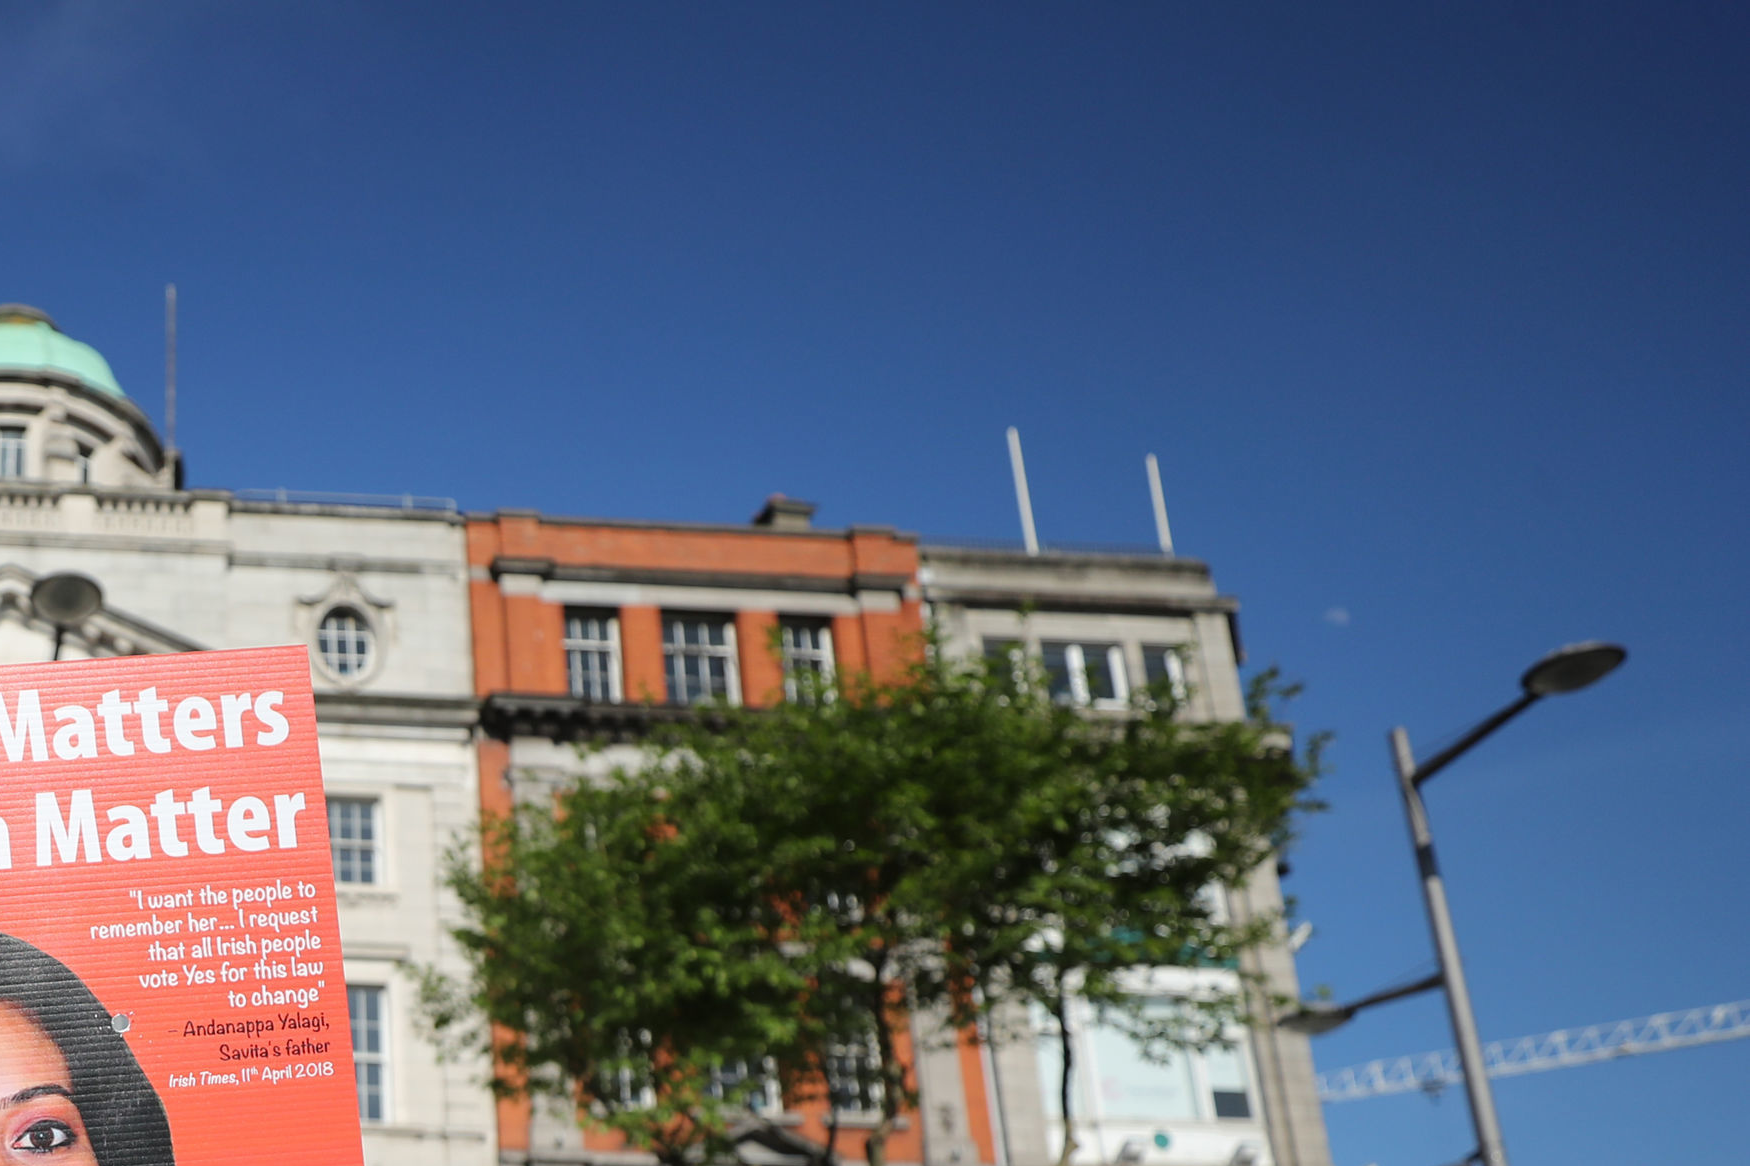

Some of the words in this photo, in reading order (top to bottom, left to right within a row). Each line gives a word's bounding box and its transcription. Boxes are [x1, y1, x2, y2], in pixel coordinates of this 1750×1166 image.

[35, 786, 306, 867] Matter
[148, 889, 193, 909] want
[199, 884, 228, 905] the
[232, 879, 293, 909] people
[297, 880, 316, 898] to
[90, 914, 183, 939] remember
[188, 911, 235, 932] her...
[238, 908, 245, 928] I
[249, 906, 318, 932] request
[148, 941, 185, 961] that
[191, 936, 213, 958] all
[216, 934, 257, 957] Irish
[261, 929, 322, 960] people
[139, 968, 179, 988] vote
[182, 964, 216, 986] Yes
[220, 962, 248, 983] for
[253, 958, 288, 980] this
[291, 956, 324, 977] law
[227, 989, 247, 1008] to
[251, 980, 326, 1009] change"
[183, 1019, 274, 1039] Andanappa
[278, 1012, 330, 1033] Yalagi,
[219, 1040, 281, 1062] Savita's
[285, 1037, 331, 1057] father
[168, 1071, 196, 1089] Irish
[200, 1070, 240, 1086] Times,
[261, 1064, 292, 1085] April
[294, 1061, 335, 1079] 2018
